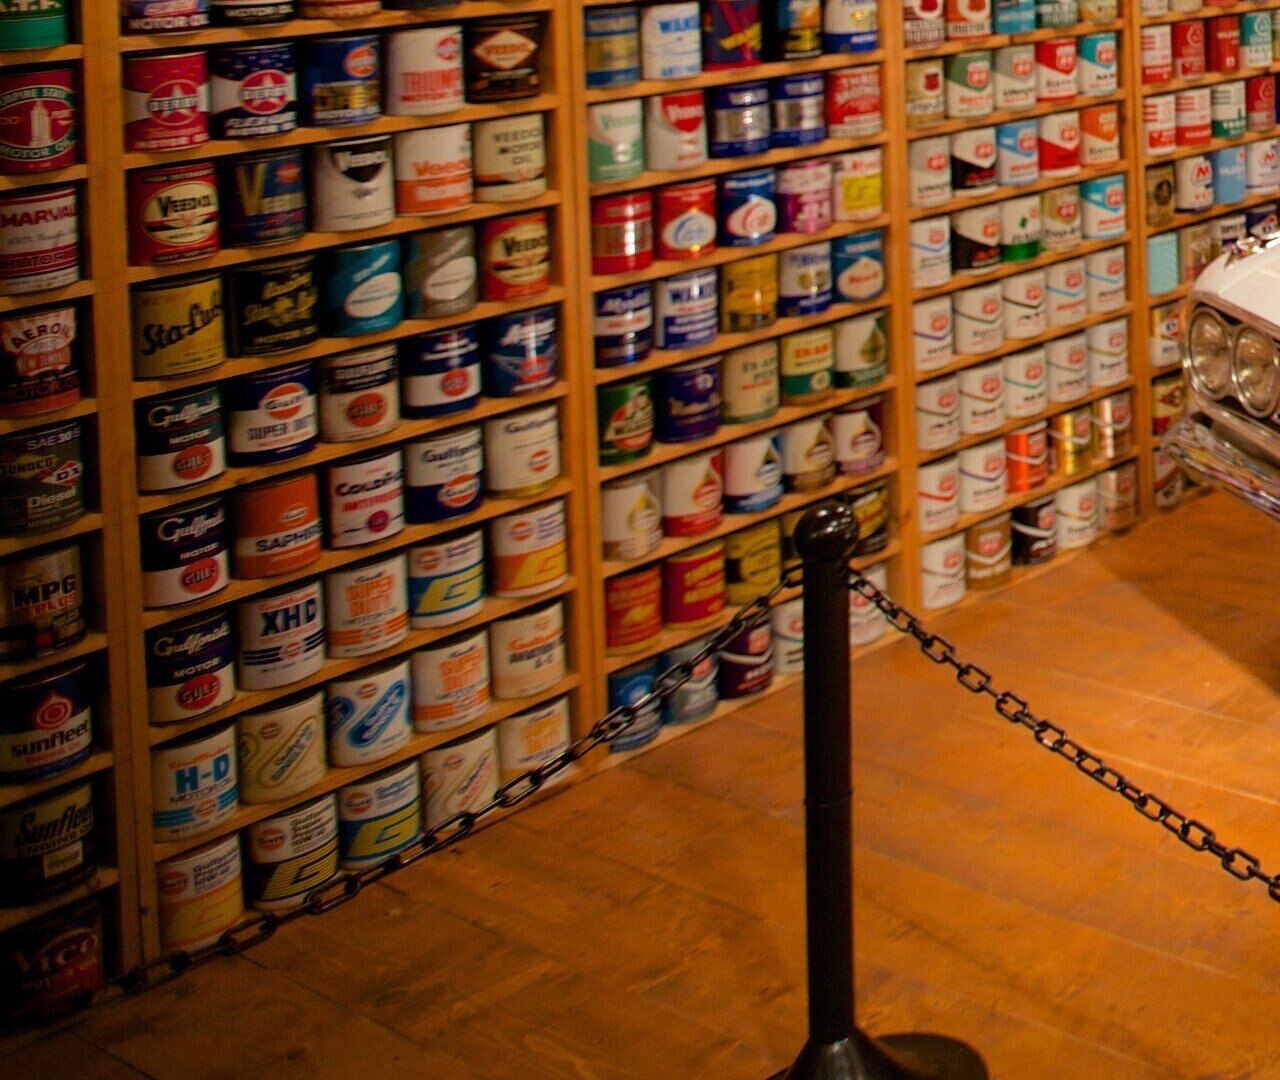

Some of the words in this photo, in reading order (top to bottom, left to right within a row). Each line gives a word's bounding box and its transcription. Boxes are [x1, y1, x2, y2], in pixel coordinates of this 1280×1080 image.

[10, 321, 72, 349] AEROIL
[181, 566, 218, 588] GULF
[11, 574, 77, 610] MPG
[259, 600, 318, 638] XHD
[173, 656, 222, 678] MOTOR
[179, 681, 219, 705] GULF
[175, 752, 230, 796] H-D
